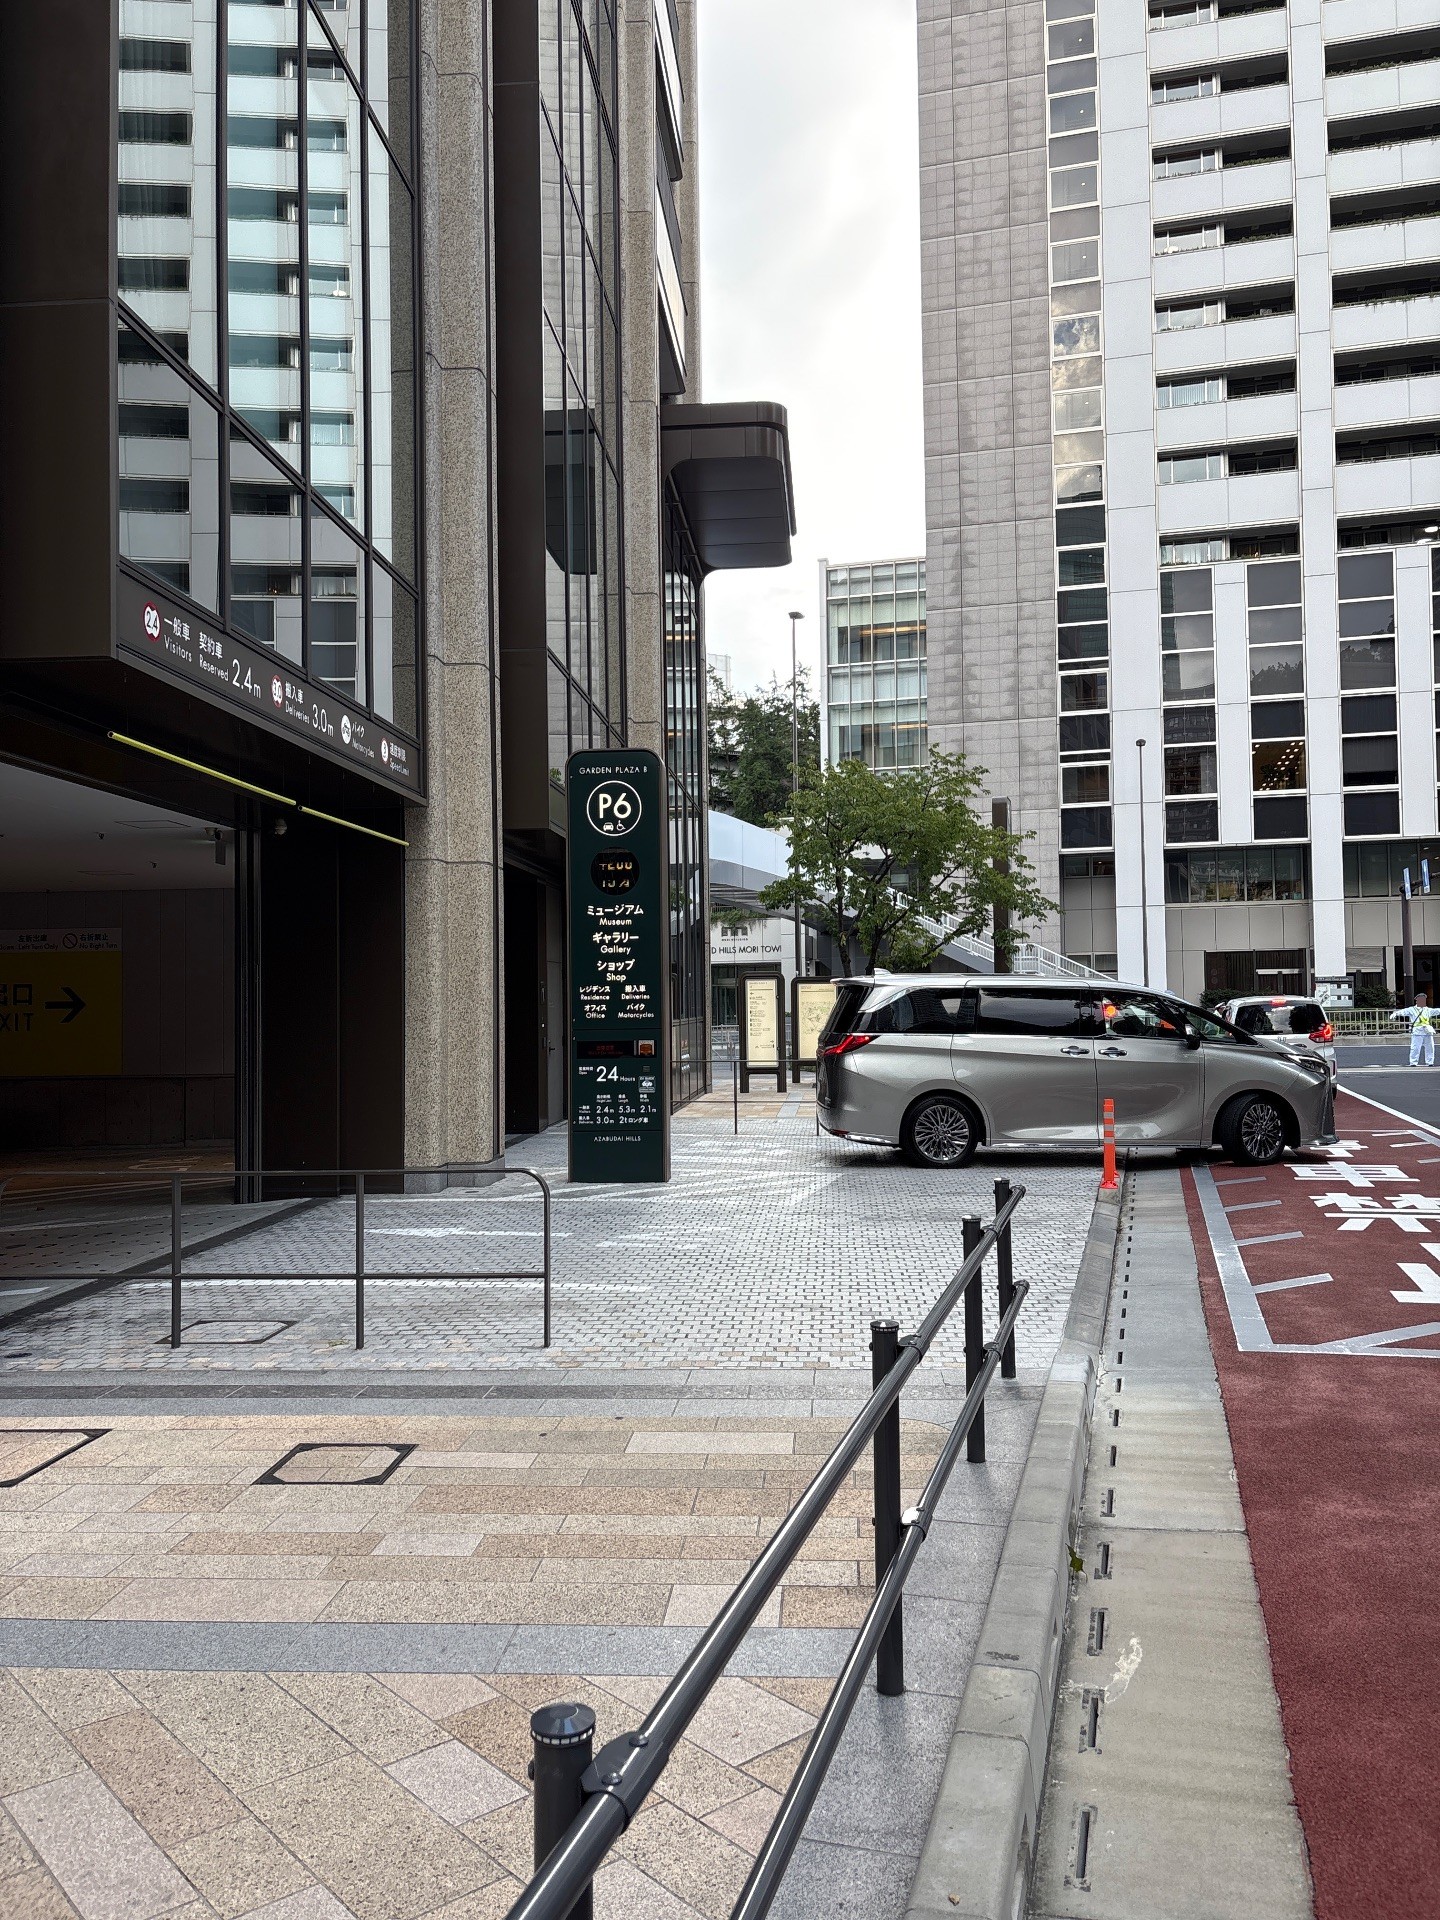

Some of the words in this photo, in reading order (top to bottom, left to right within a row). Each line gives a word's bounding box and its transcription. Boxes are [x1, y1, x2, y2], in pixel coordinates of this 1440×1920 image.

[164, 616, 191, 642] 一般車
[199, 632, 223, 660] 契約車
[164, 634, 192, 663] Visitors
[199, 653, 229, 681] Reserved
[285, 700, 310, 724] Deliveries
[352, 721, 365, 738] バイク
[579, 766, 612, 774] GARDEN
[615, 766, 640, 774] PLAZA
[643, 765, 648, 773] B
[598, 792, 632, 819] P6
[587, 904, 644, 916] ミュージアム
[599, 917, 633, 926] Museum
[79, 933, 109, 941] 右折禁止
[592, 931, 640, 943] ギャラリー
[43, 943, 59, 951] Only
[600, 944, 632, 955] Gallery
[718, 946, 737, 954] HILLS
[738, 945, 759, 953] MORI
[596, 958, 636, 971] ショップ
[606, 972, 627, 983] Shop
[579, 985, 611, 993] レジデンス
[624, 985, 646, 993] 搬入車
[580, 993, 610, 1001] Residence
[584, 1004, 607, 1012] オフィス
[626, 1003, 646, 1011] バイク
[585, 1011, 606, 1019] Office
[617, 1011, 655, 1020] Motorcycles
[596, 1065, 619, 1082] 24
